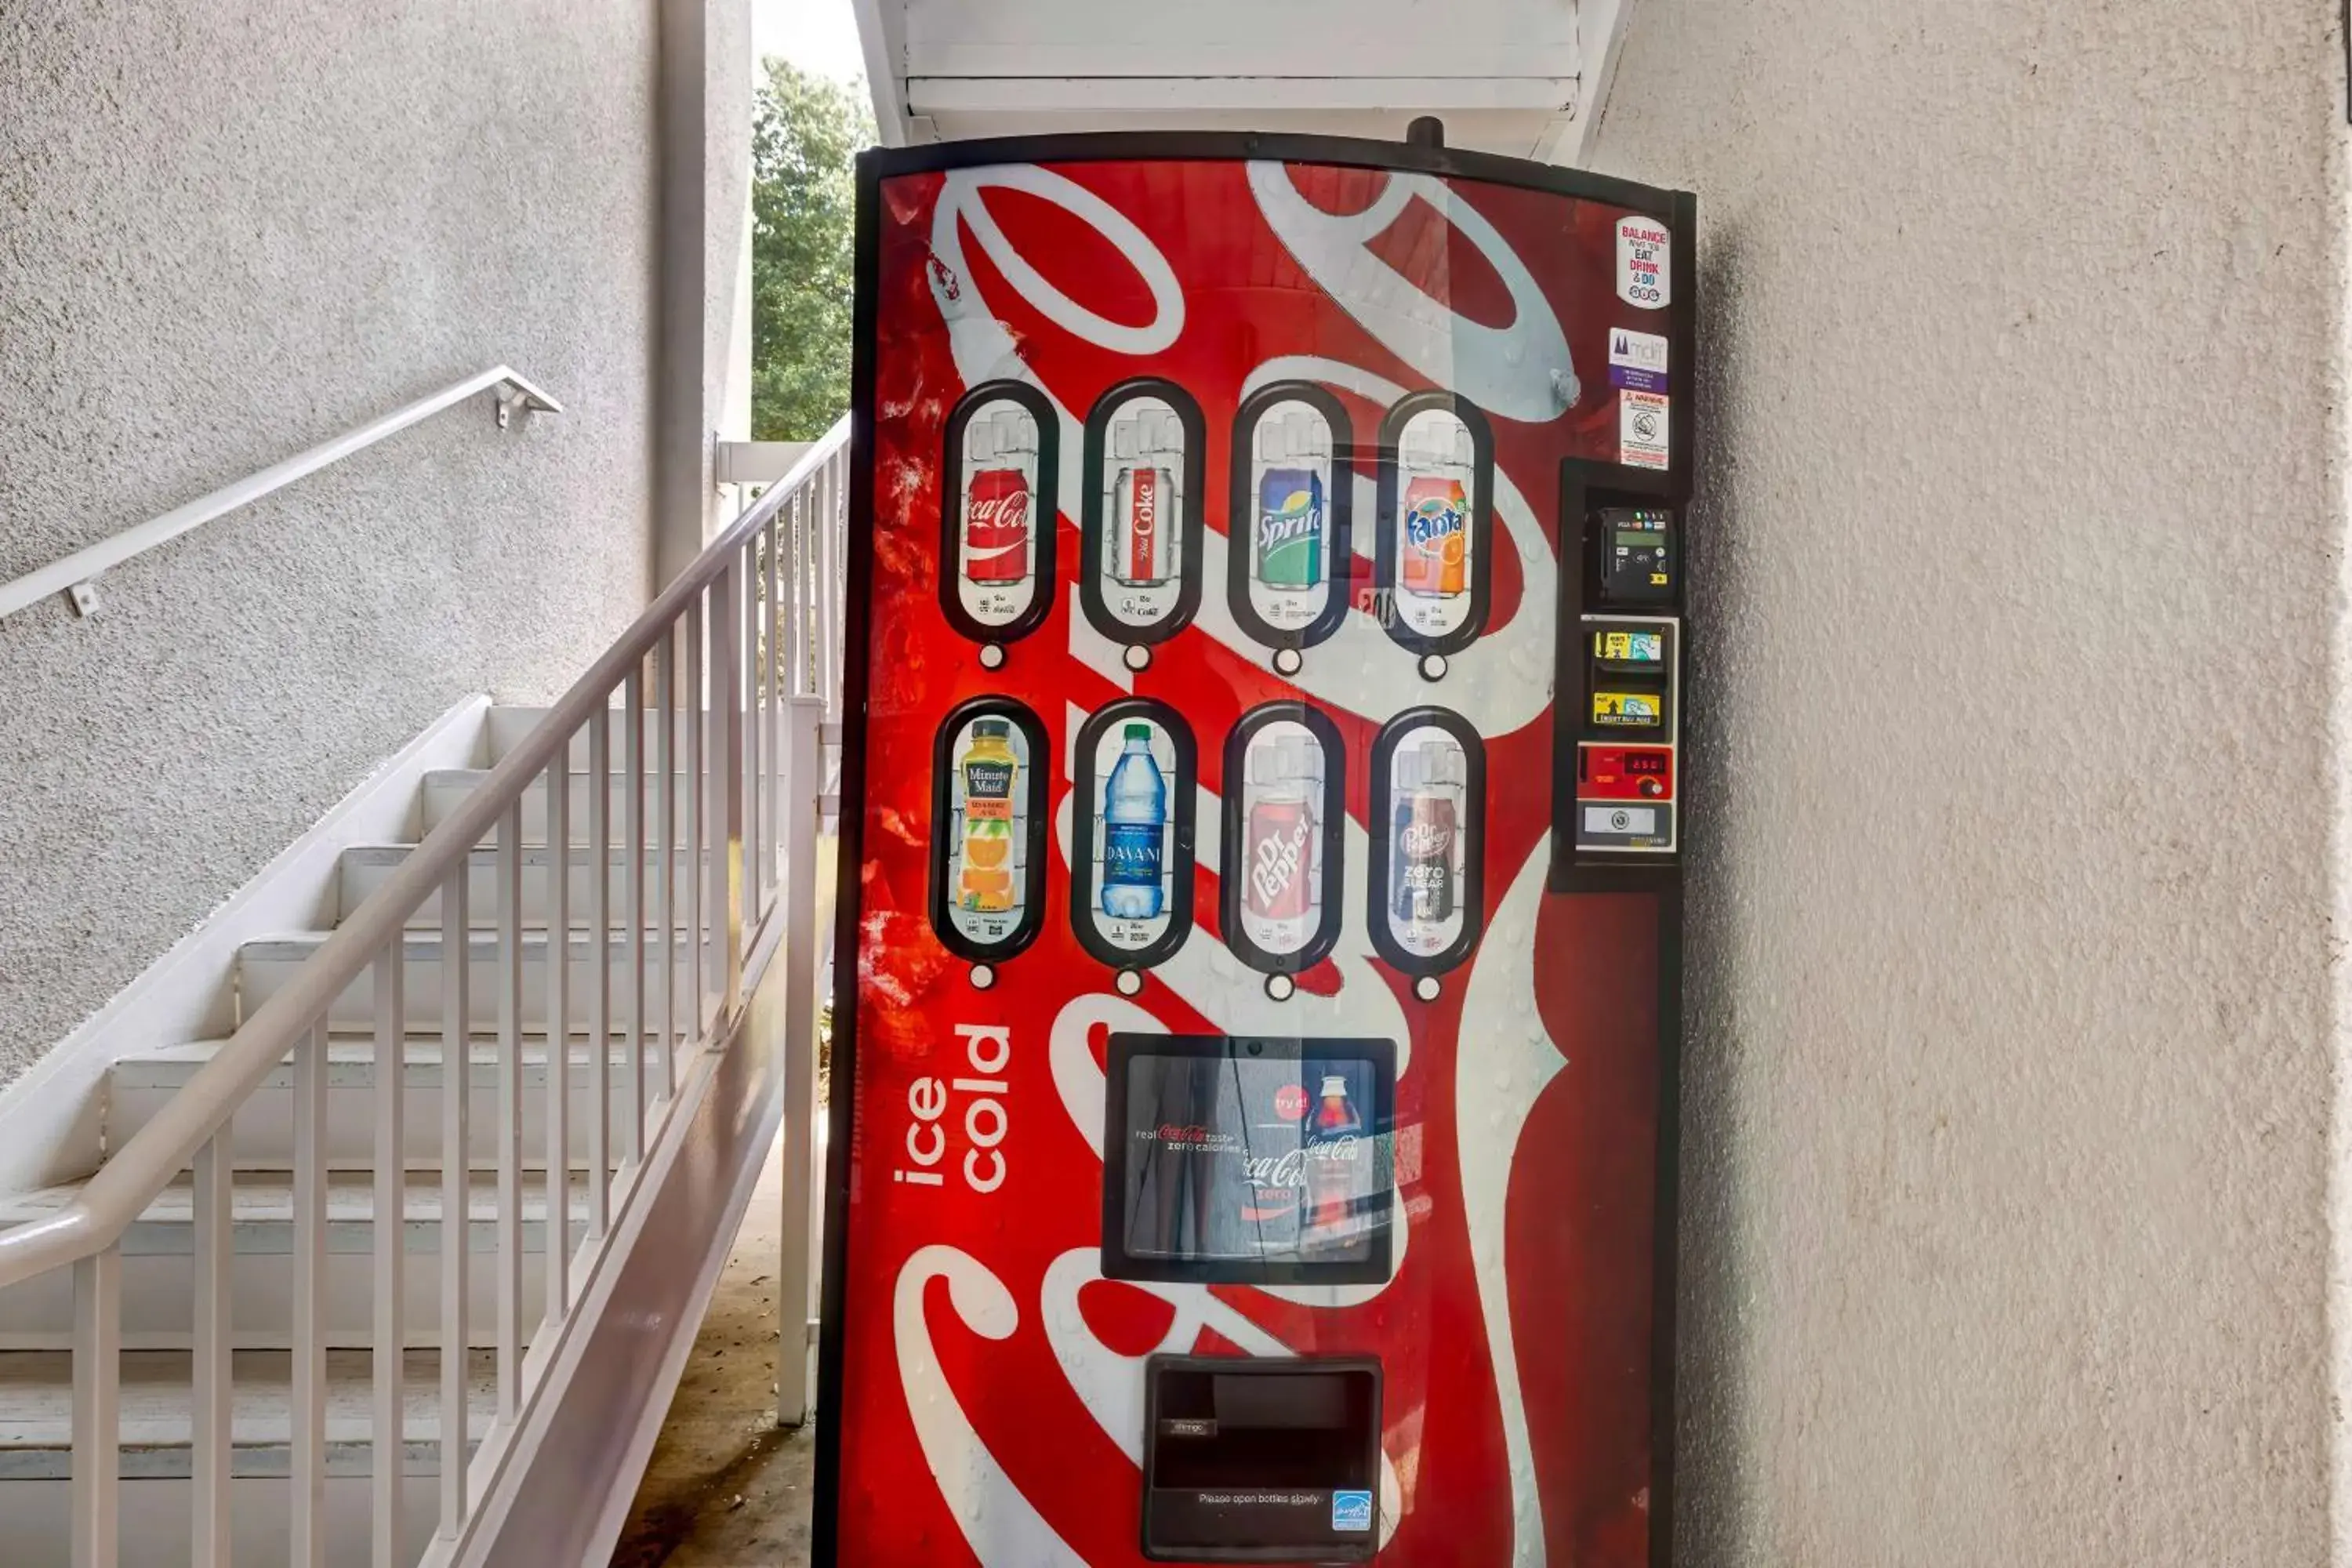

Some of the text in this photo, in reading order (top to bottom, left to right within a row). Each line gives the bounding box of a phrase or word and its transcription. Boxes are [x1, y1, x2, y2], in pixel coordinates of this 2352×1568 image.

[1622, 226, 1666, 245] BALANCE
[1635, 249, 1653, 261] EAT
[1630, 260, 1660, 274] DRINK
[1642, 274, 1655, 285] DO
[1134, 484, 1153, 535] Coke
[1259, 508, 1321, 550] Sprite
[970, 768, 1010, 780] Minute
[975, 780, 1004, 792] Maid
[1257, 829, 1285, 867] Dr
[1252, 813, 1312, 907] Pepper
[1404, 866, 1444, 879] zero
[953, 1023, 1011, 1194] cold
[1276, 1098, 1292, 1109] try
[894, 1076, 947, 1186] ice
[1136, 1130, 1156, 1139] real
[1206, 1133, 1234, 1142] taste
[1167, 1142, 1241, 1152] zero calories
[1256, 1189, 1292, 1200] zero
[1199, 1494, 1320, 1505] Please open bottles slowly
